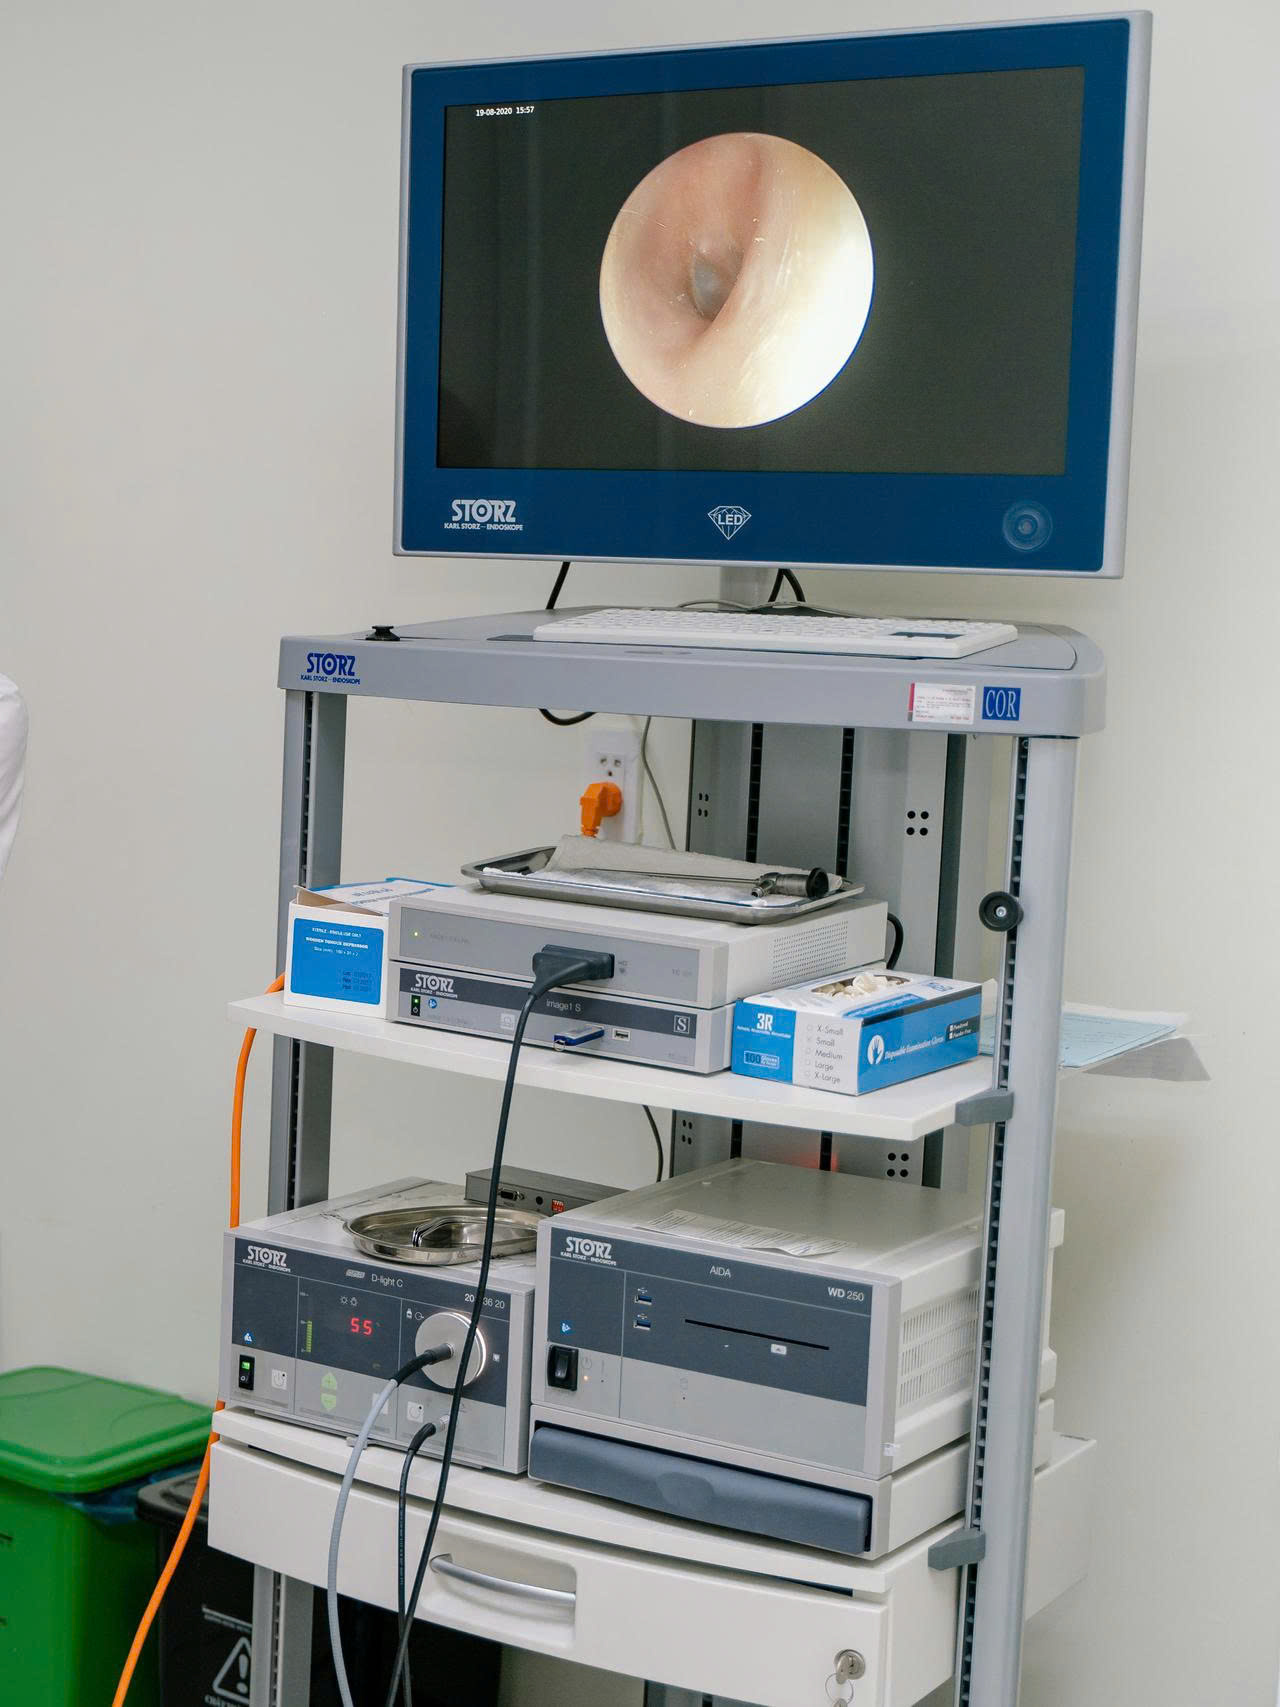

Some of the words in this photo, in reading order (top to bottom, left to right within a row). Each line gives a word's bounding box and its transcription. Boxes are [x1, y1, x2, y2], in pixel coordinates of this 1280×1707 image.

[516, 106, 535, 114] 15:57
[451, 498, 517, 523] STORZ
[444, 522, 460, 530] KARL
[486, 523, 524, 531] ENDOSKOPE
[717, 514, 744, 526] LED
[306, 652, 356, 677] STORZ
[313, 675, 328, 683] STORZ
[332, 676, 361, 685] ENDOSKOPE
[985, 689, 1017, 718] COR
[415, 973, 454, 993] STORZ
[575, 1003, 581, 1012] S
[676, 1016, 687, 1032] S
[756, 1012, 774, 1031] 3R
[816, 1036, 835, 1047] Small
[815, 1049, 843, 1060] Medium
[814, 1060, 834, 1072] Large
[814, 1071, 841, 1084] X-Large
[566, 1236, 612, 1259] STORZ
[247, 1245, 287, 1267] STORZ
[572, 1253, 587, 1261] STORZ
[709, 1265, 732, 1278] AIDA
[371, 1273, 395, 1287] D-light
[396, 1279, 404, 1288] C
[827, 1286, 846, 1298] WD
[846, 1290, 865, 1302] 250
[494, 1299, 505, 1309] 20
[351, 1317, 374, 1336] 55
